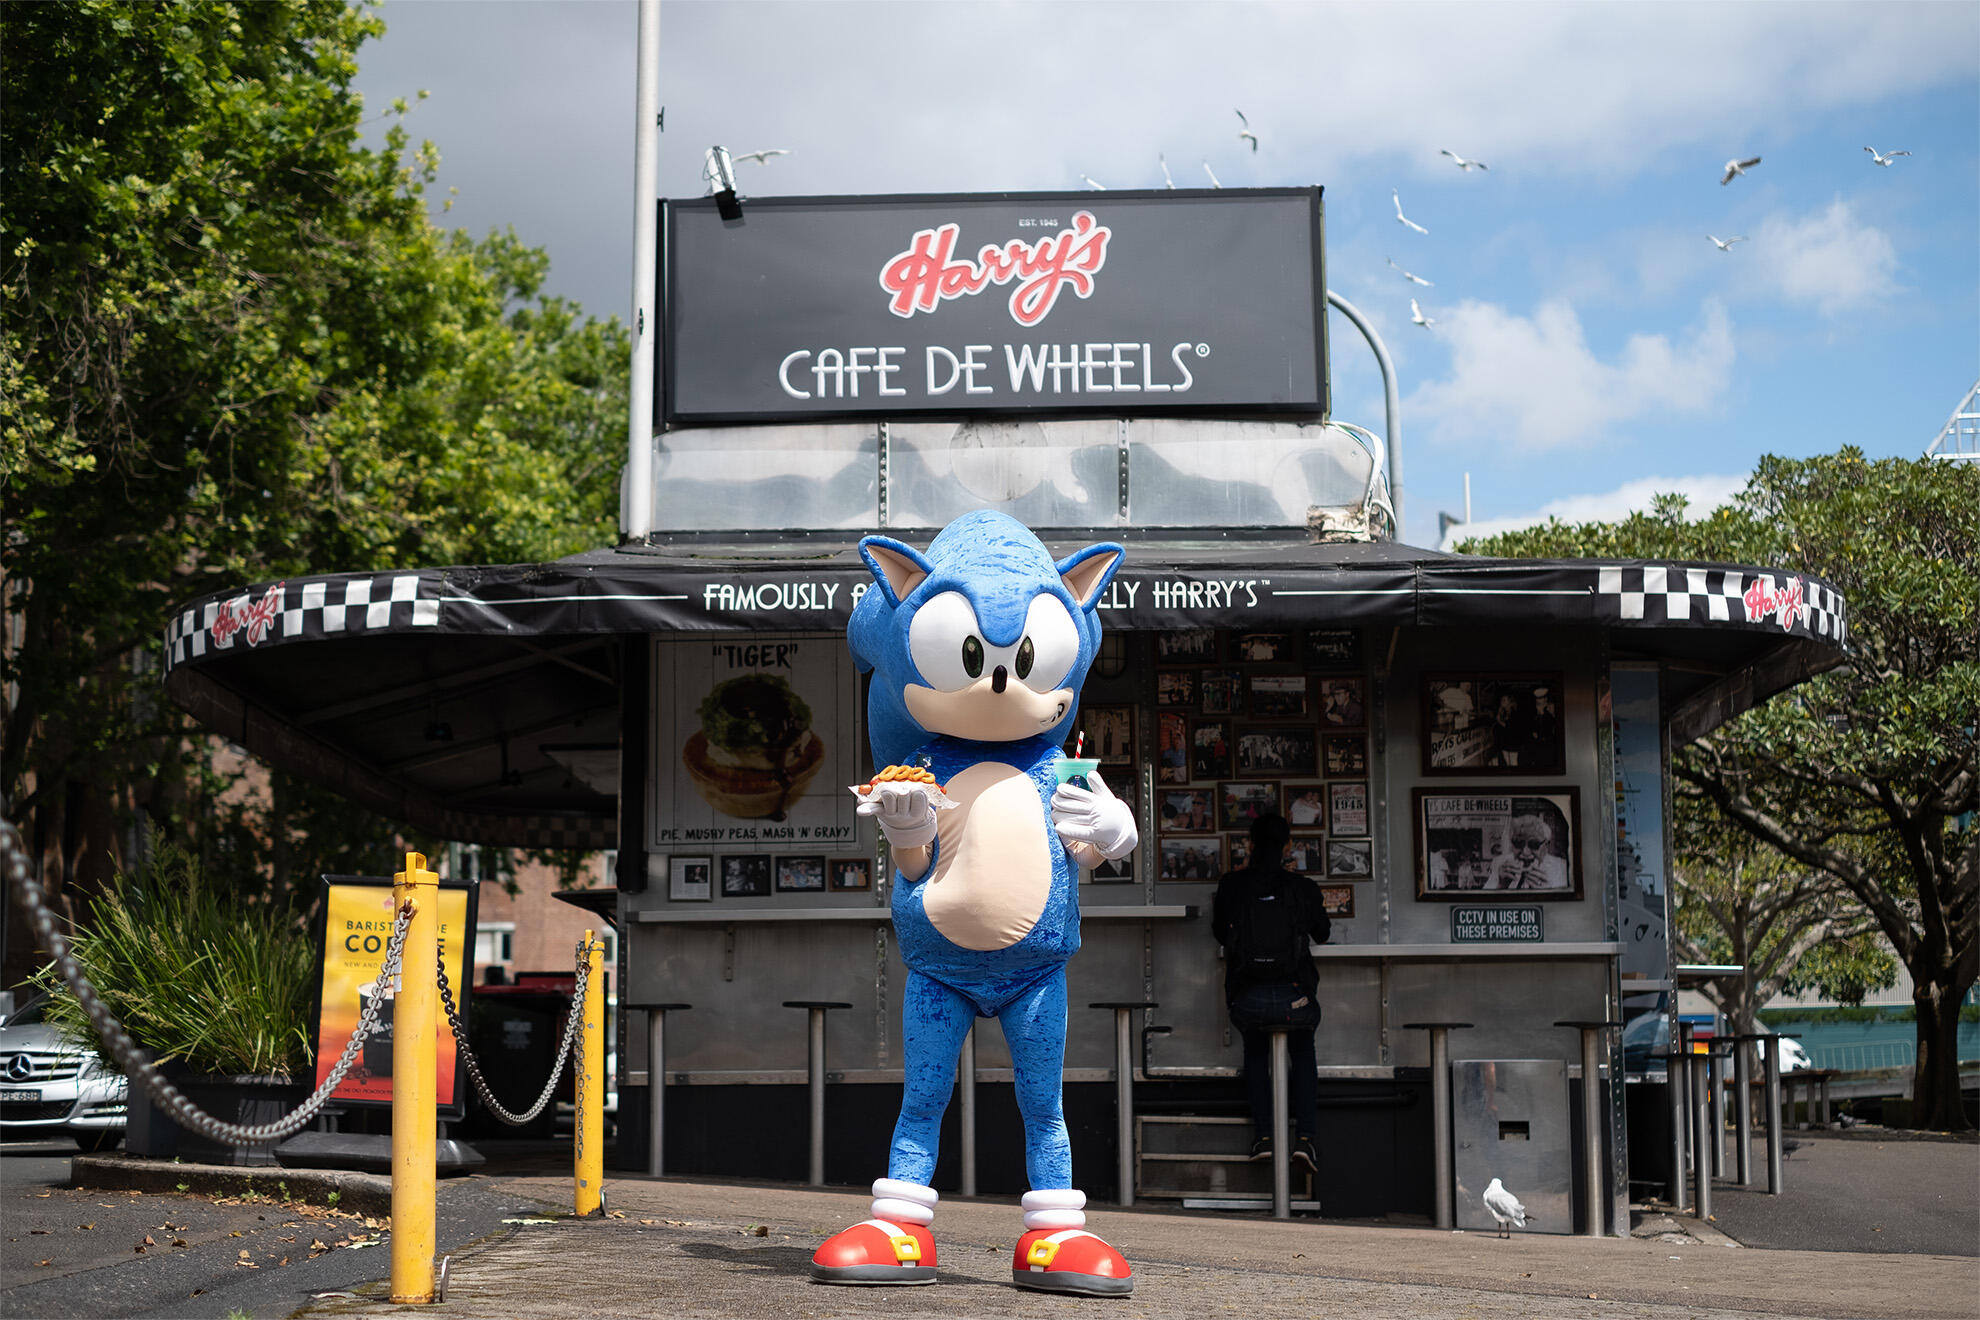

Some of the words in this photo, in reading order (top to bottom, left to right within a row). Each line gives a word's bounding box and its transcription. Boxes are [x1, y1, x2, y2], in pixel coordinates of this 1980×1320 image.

[880, 210, 1111, 327] Harry's
[778, 346, 906, 399] CAFE
[926, 344, 993, 394] DE
[703, 582, 841, 611] FAMOUSLY
[1743, 574, 1804, 632] Harry's
[211, 583, 284, 647] Harry's
[686, 828, 725, 840] MUSHY
[762, 827, 795, 839] MASH
[814, 826, 850, 839] GRAVY
[346, 920, 394, 932] BARIST
[1459, 909, 1484, 924] CCTV
[1486, 909, 1497, 923] IN
[1499, 909, 1519, 923] USE
[1521, 909, 1536, 923] ON
[1456, 925, 1487, 939] THESE
[1489, 924, 1539, 939] PREMISES
